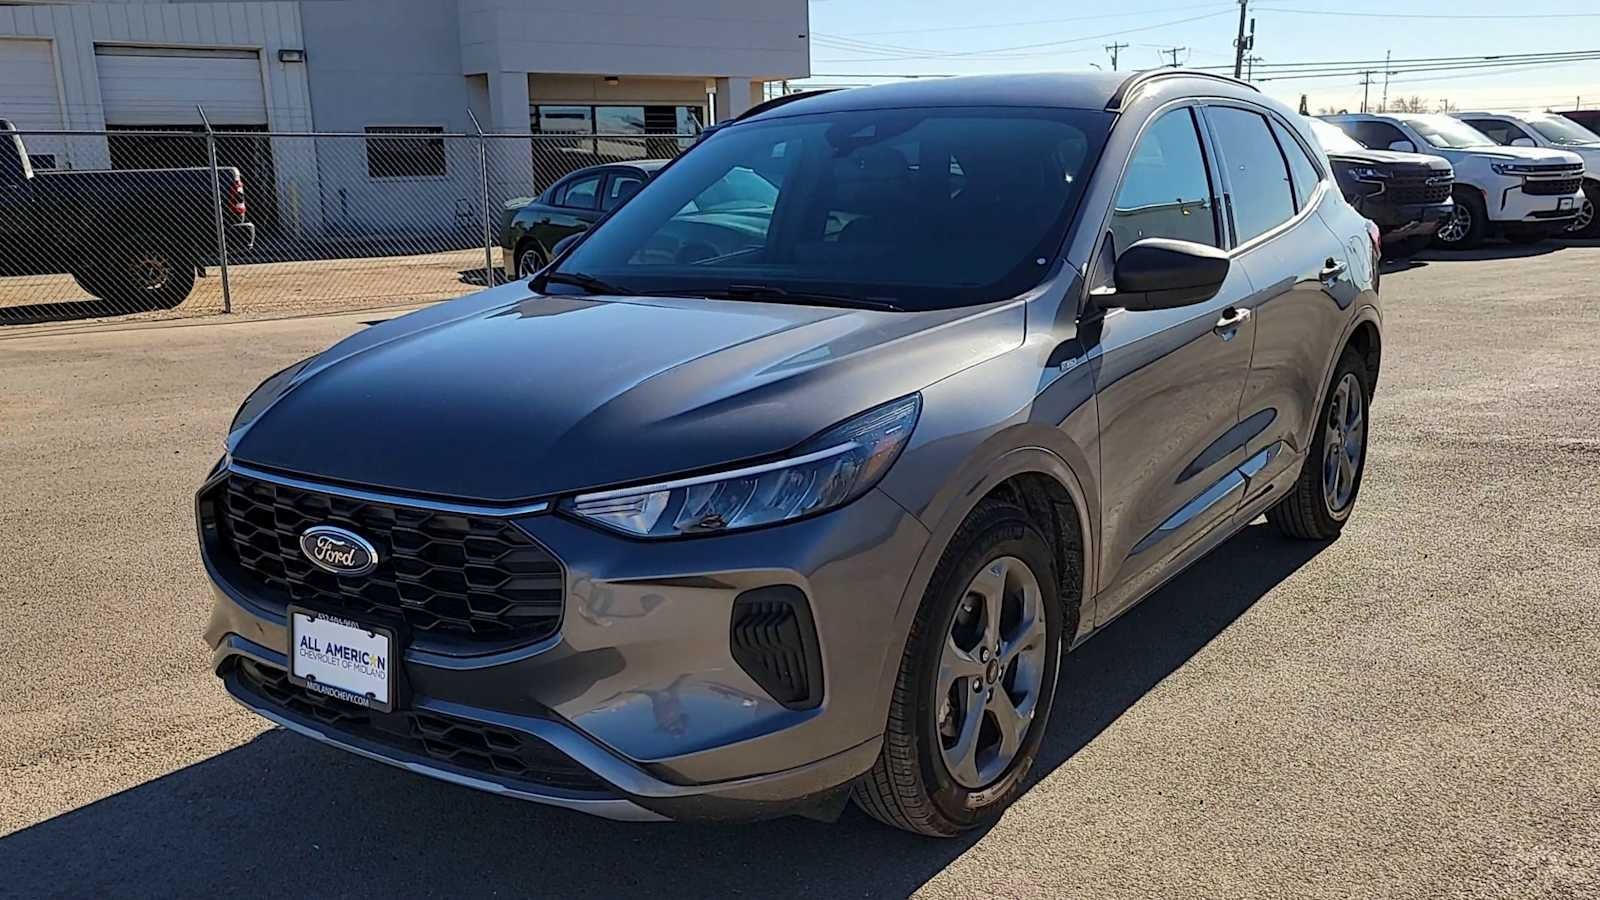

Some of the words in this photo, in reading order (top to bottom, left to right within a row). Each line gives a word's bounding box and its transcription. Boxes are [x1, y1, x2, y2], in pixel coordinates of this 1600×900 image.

[314, 535, 357, 567] Ford
[300, 635, 321, 653] ALL
[299, 648, 340, 667] CHEVROLET
[341, 659, 352, 669] OF
[353, 662, 386, 681] MIDLAND
[306, 681, 370, 707] MIDLANDCHEVY.COM
